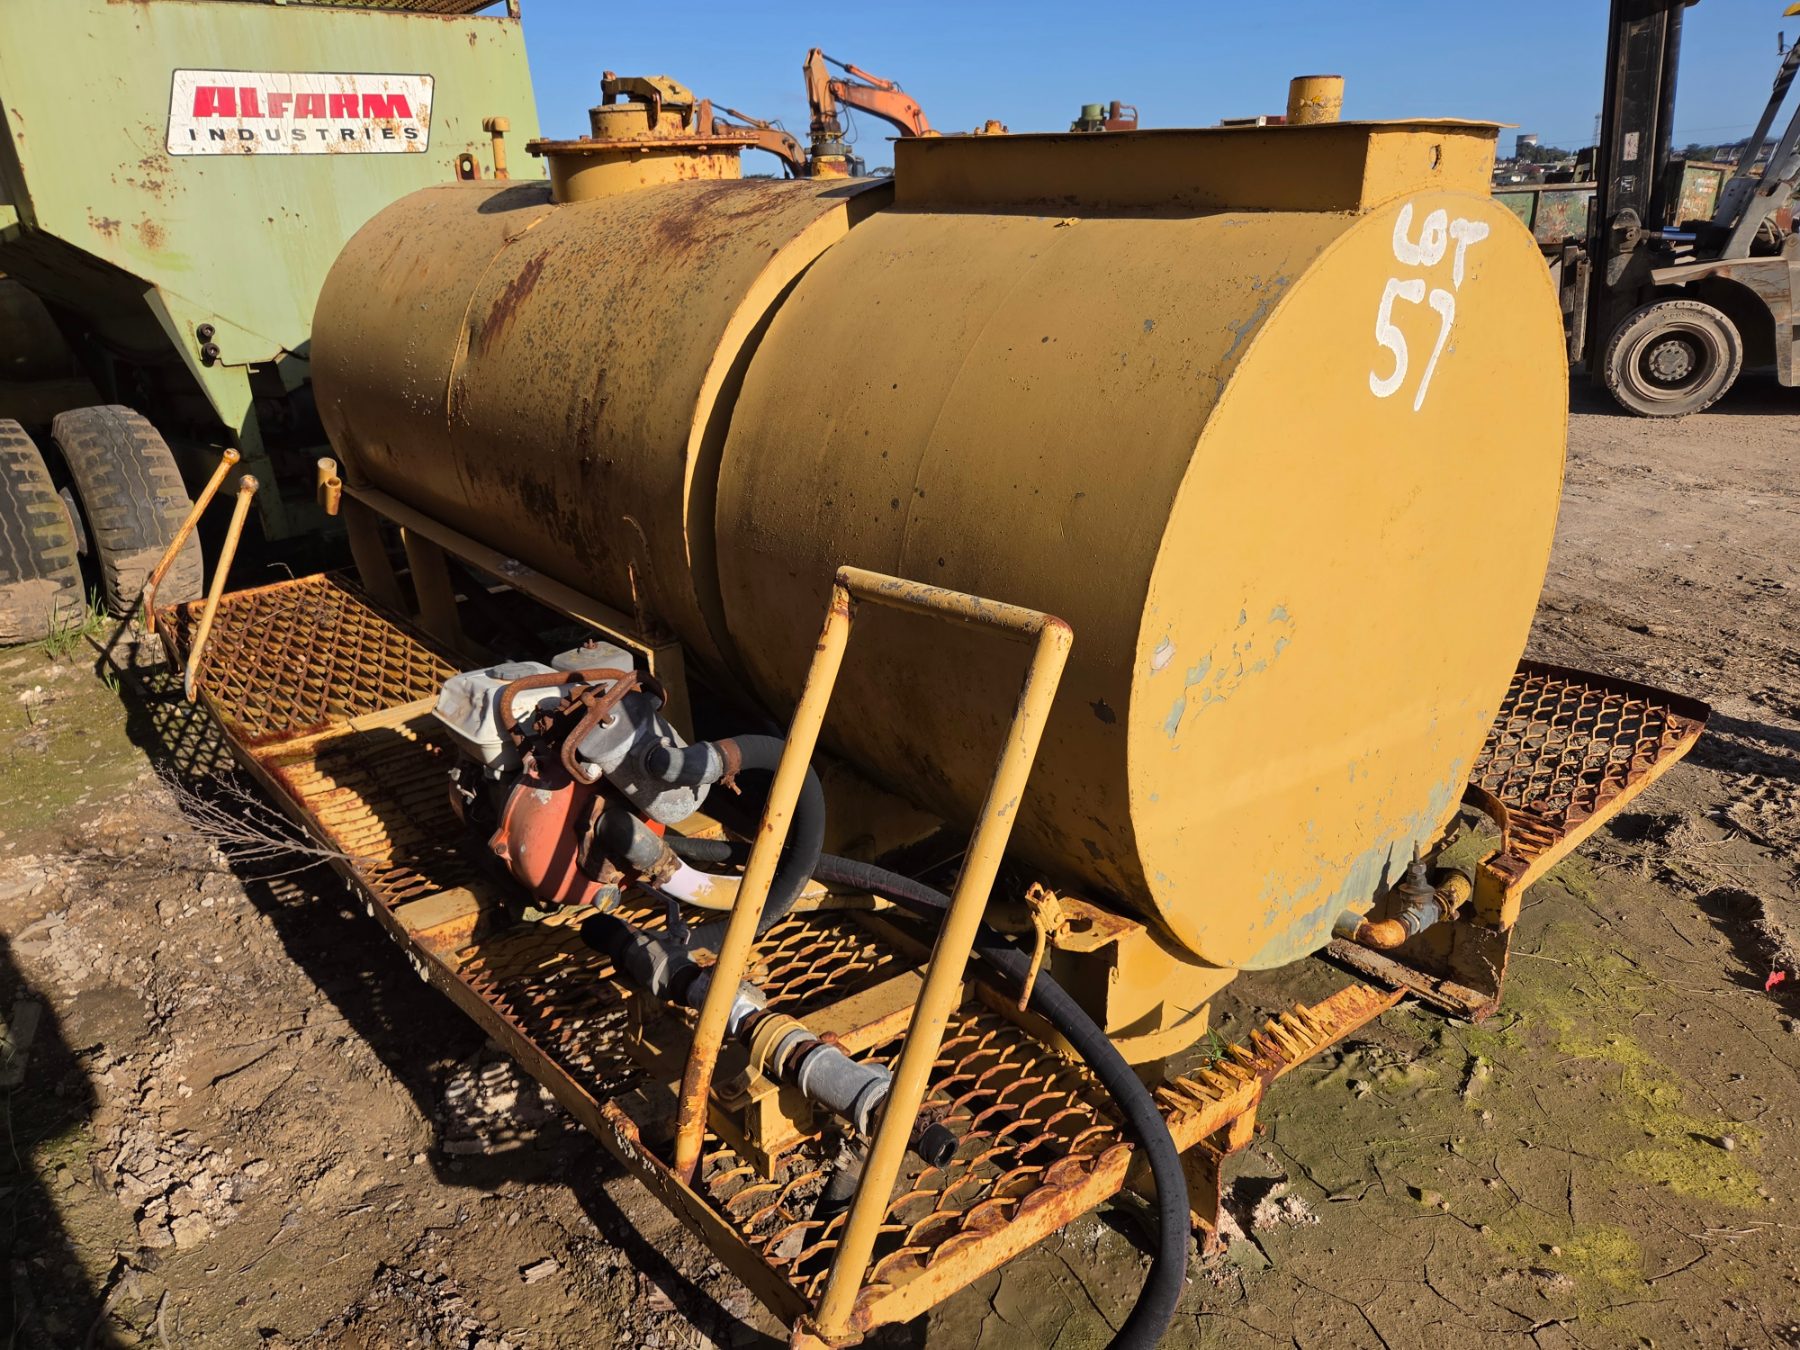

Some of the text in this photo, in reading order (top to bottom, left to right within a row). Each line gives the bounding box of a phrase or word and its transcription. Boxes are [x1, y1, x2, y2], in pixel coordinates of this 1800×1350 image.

[192, 86, 413, 118] ALFARM
[188, 128, 418, 141] INDUSTRIES
[1392, 203, 1490, 292] LOT
[1369, 277, 1456, 412] 57
